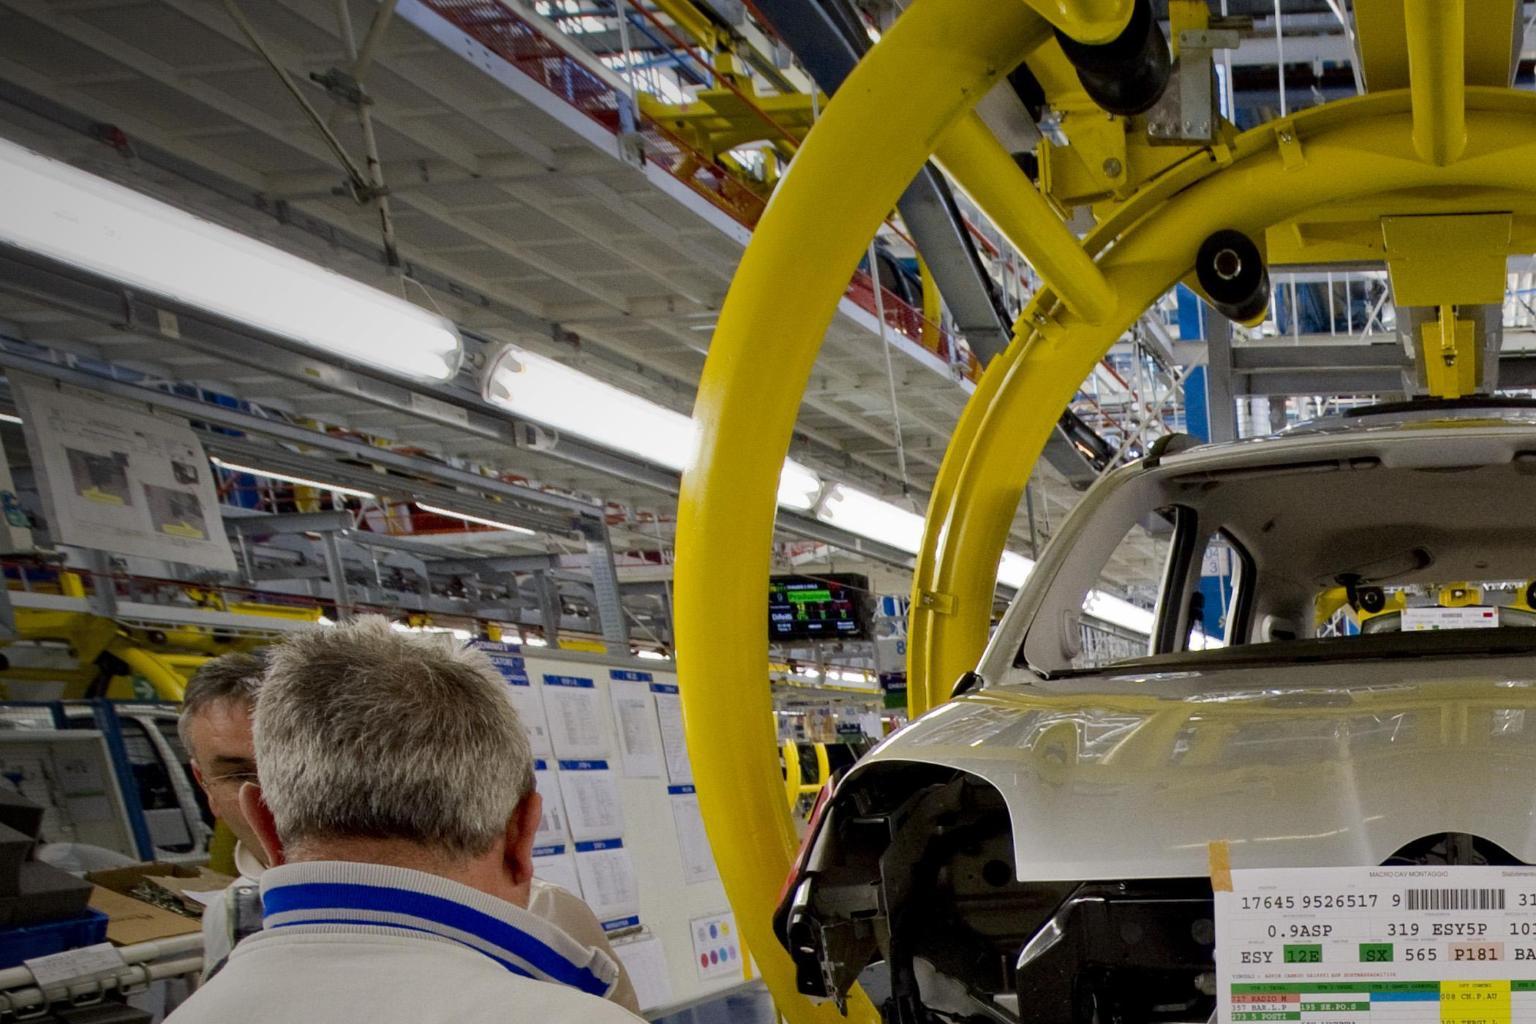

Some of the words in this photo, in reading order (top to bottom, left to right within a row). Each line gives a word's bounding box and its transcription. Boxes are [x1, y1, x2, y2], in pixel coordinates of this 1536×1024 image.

[1242, 896, 1295, 909] 17645
[1303, 894, 1378, 908] 9526517
[1392, 894, 1401, 907] 9
[1267, 924, 1333, 938] 0.9ASP
[1387, 923, 1419, 936] 319
[1432, 923, 1488, 936] ESY5P
[1241, 951, 1274, 963] ESY
[1287, 950, 1320, 962] 12E
[1366, 949, 1387, 961] SX
[1405, 948, 1437, 961] 565
[1455, 948, 1498, 960] P181
